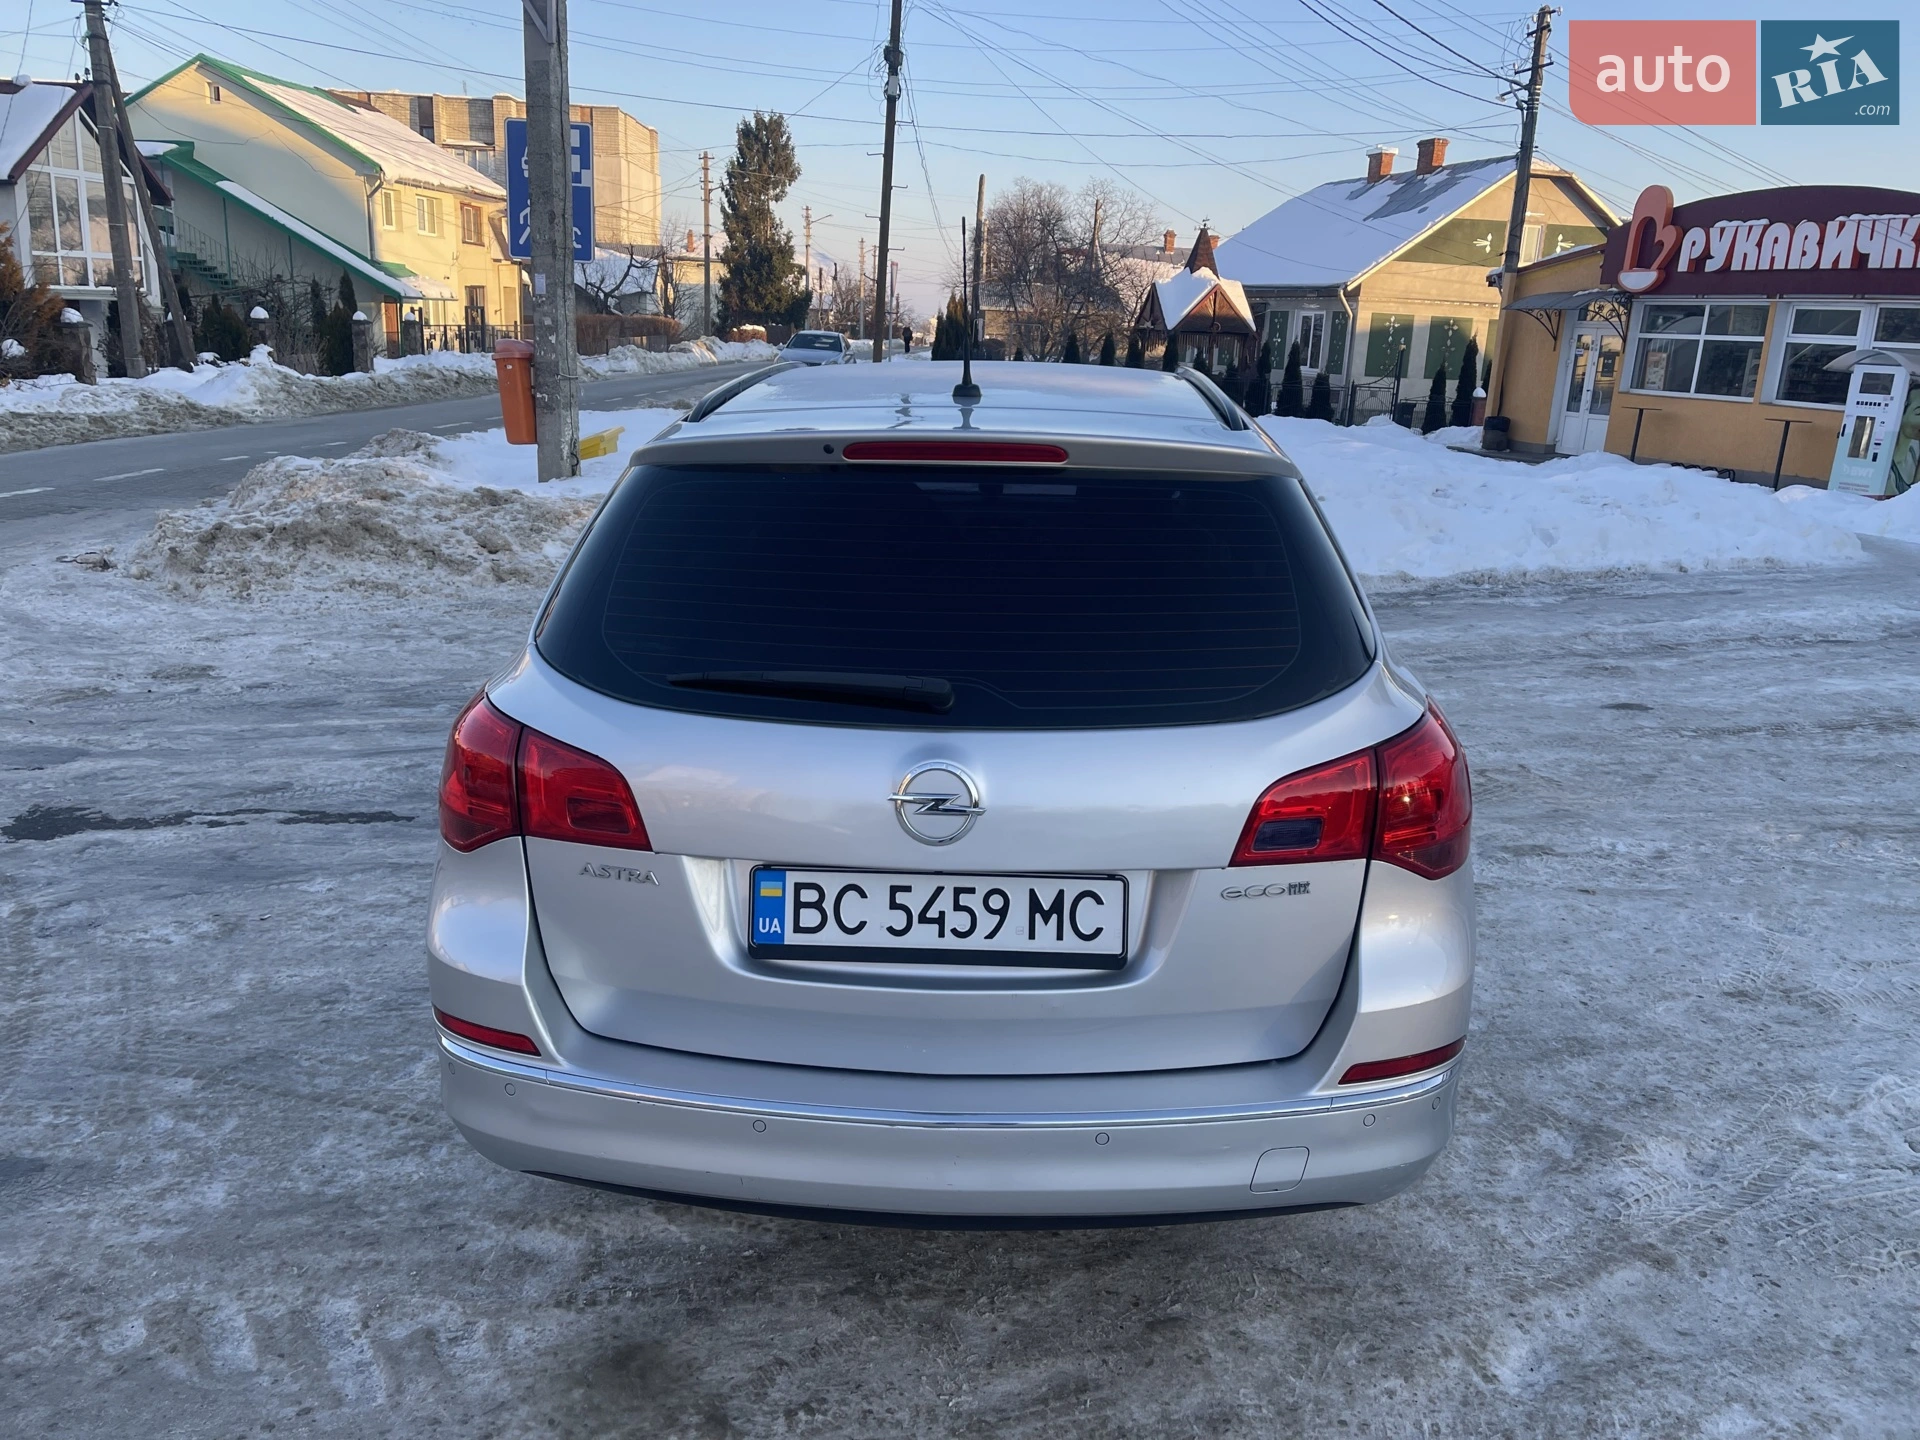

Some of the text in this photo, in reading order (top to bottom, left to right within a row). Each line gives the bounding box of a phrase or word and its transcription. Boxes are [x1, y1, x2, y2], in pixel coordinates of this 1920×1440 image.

[1677, 217, 1920, 273] РУКАВИЧК
[578, 862, 660, 886] ASTRA
[758, 917, 782, 934] UA
[792, 882, 1105, 942] BC 5459 MC
